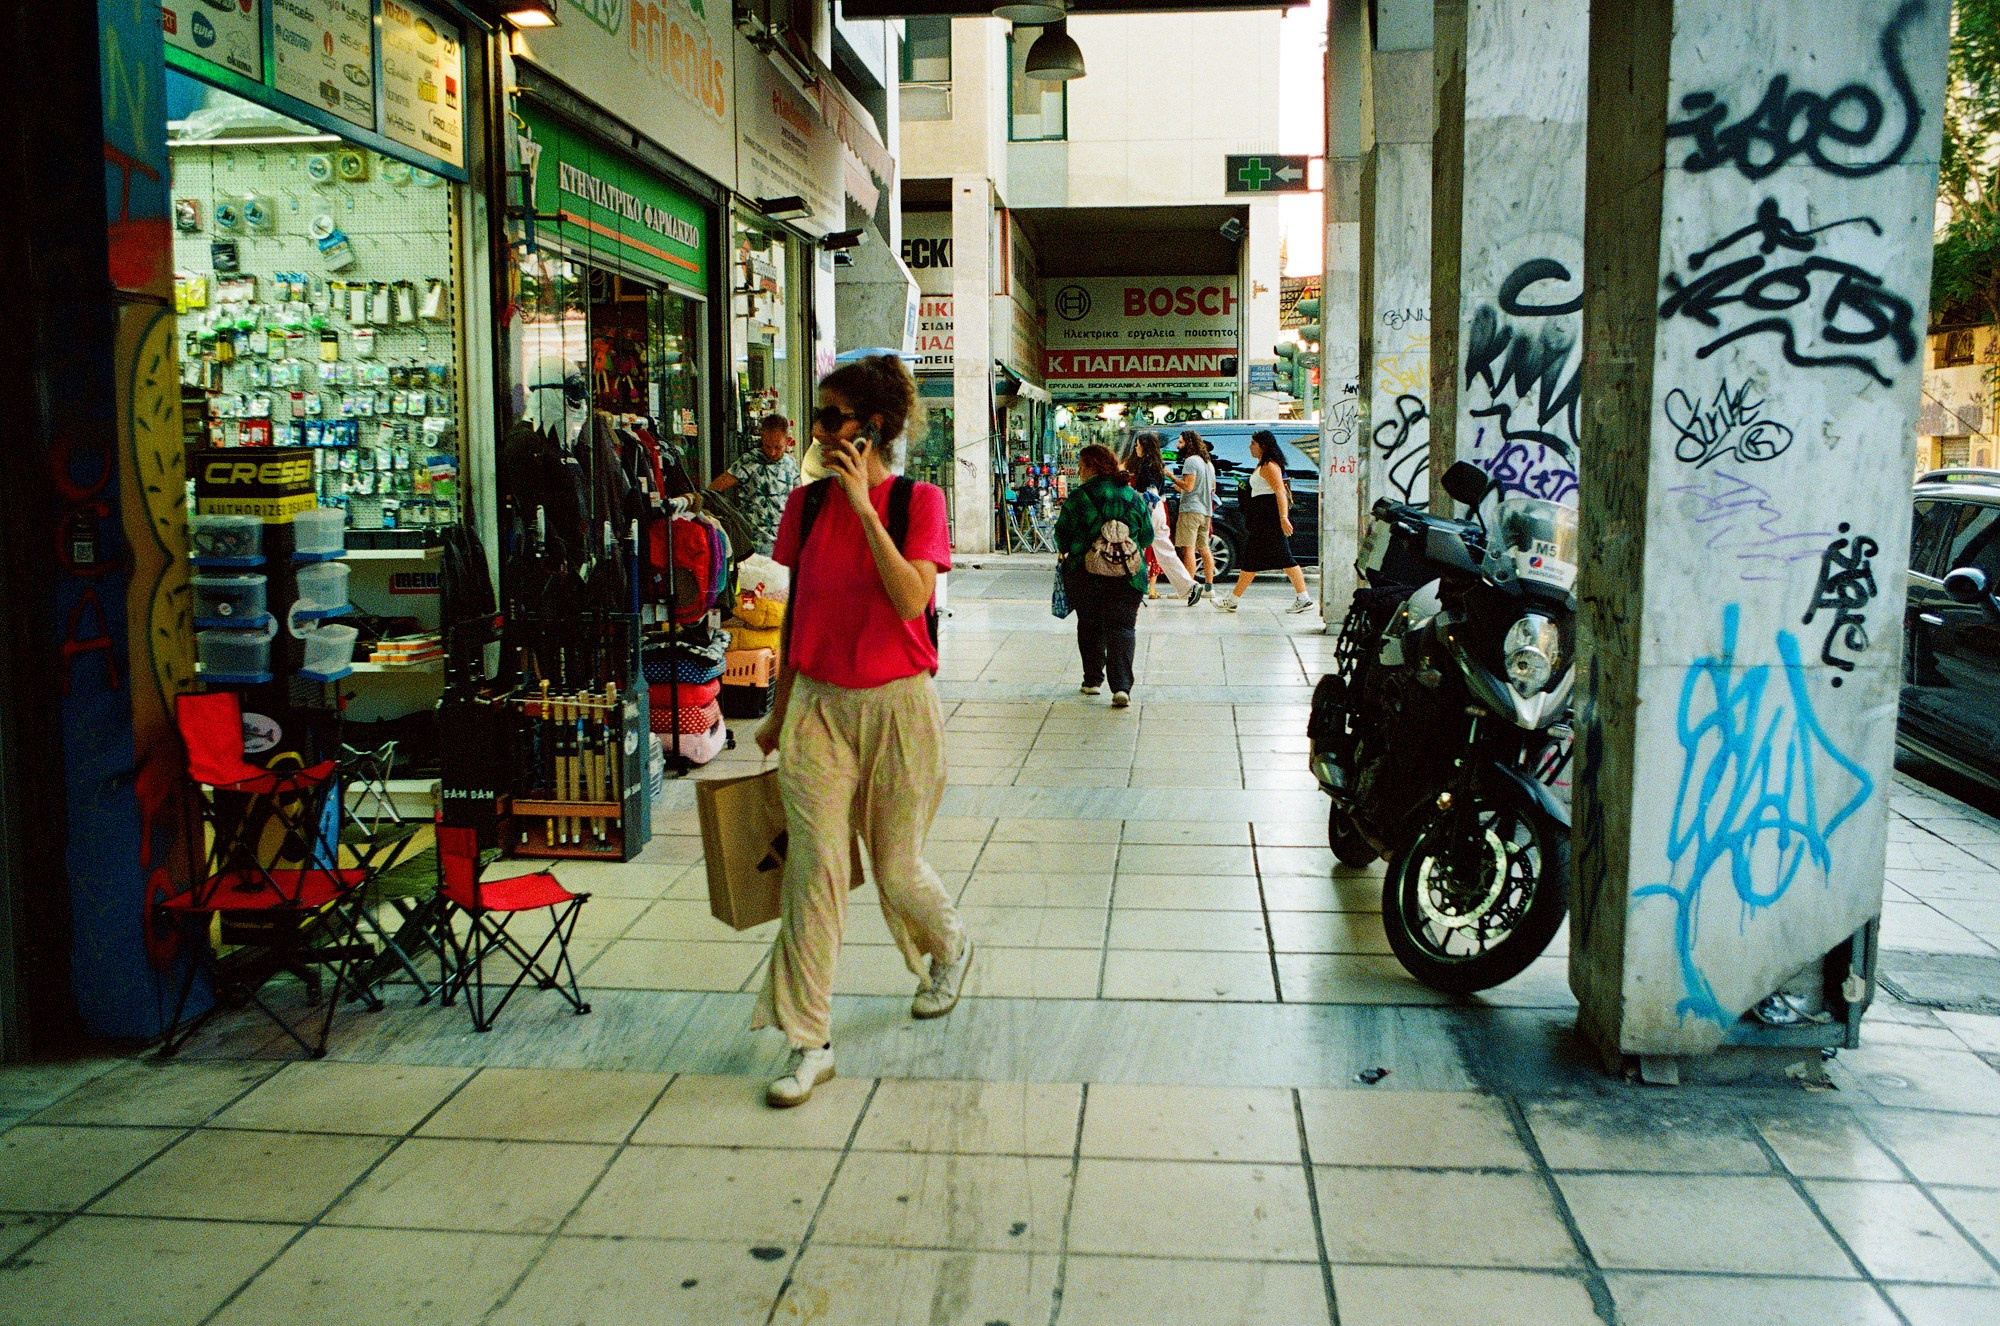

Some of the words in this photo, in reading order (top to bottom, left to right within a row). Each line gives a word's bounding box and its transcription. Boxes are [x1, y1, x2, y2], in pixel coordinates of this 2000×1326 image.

[559, 160, 641, 223] ΚΤΗΝΙΑΤΡΙΚΟ
[643, 202, 700, 250] ΦΑΡΜΑΚΕΙΟ
[1048, 356, 1068, 373] Κ.
[204, 459, 311, 485] CRESSI
